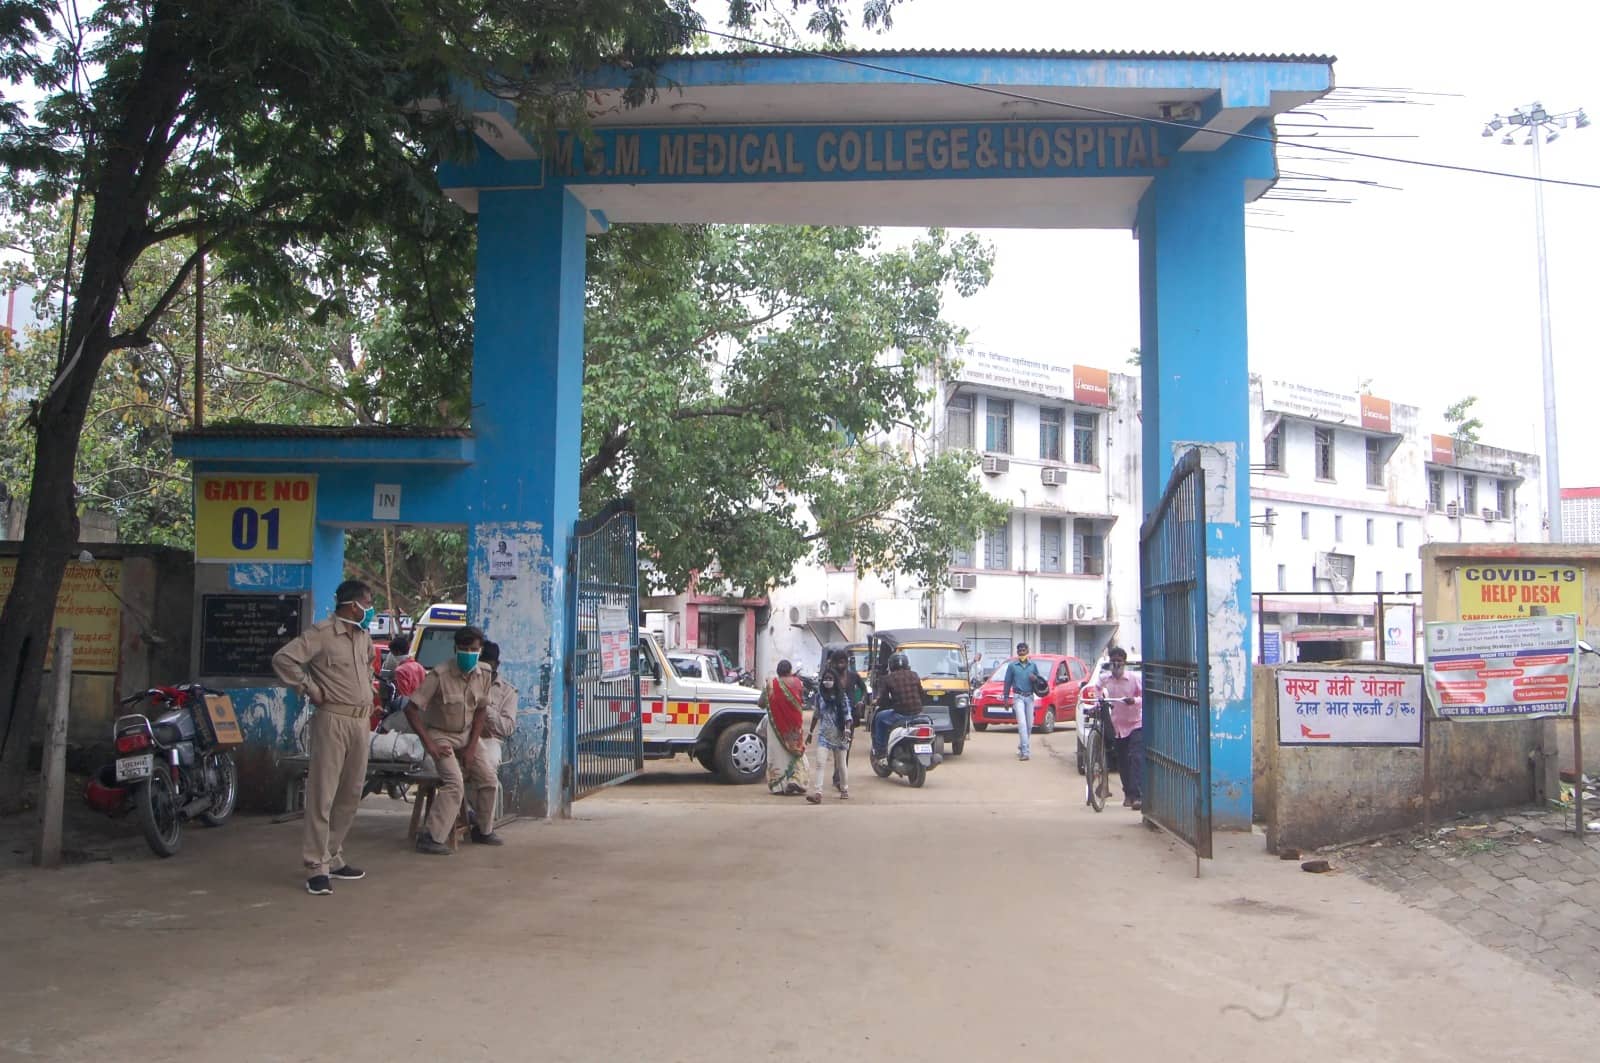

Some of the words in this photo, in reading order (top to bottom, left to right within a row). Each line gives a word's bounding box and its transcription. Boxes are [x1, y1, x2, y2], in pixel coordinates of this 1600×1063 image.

[659, 131, 804, 175] MEDICAL
[816, 128, 969, 173] COLLEGE
[976, 130, 998, 168] &
[1005, 125, 1170, 170] HOSPITAL
[204, 480, 267, 501] GATE
[273, 480, 310, 501] NO
[378, 493, 396, 507] IN
[231, 506, 280, 550] 01
[1465, 568, 1576, 582] COVID-19
[1481, 585, 1517, 603] HELP
[1521, 585, 1561, 603] DESK
[1325, 675, 1355, 696] मंत्री
[1360, 676, 1405, 697] योजना
[1295, 702, 1320, 716] दाल
[1325, 702, 1350, 717] भात
[1352, 698, 1383, 716] सब्जी
